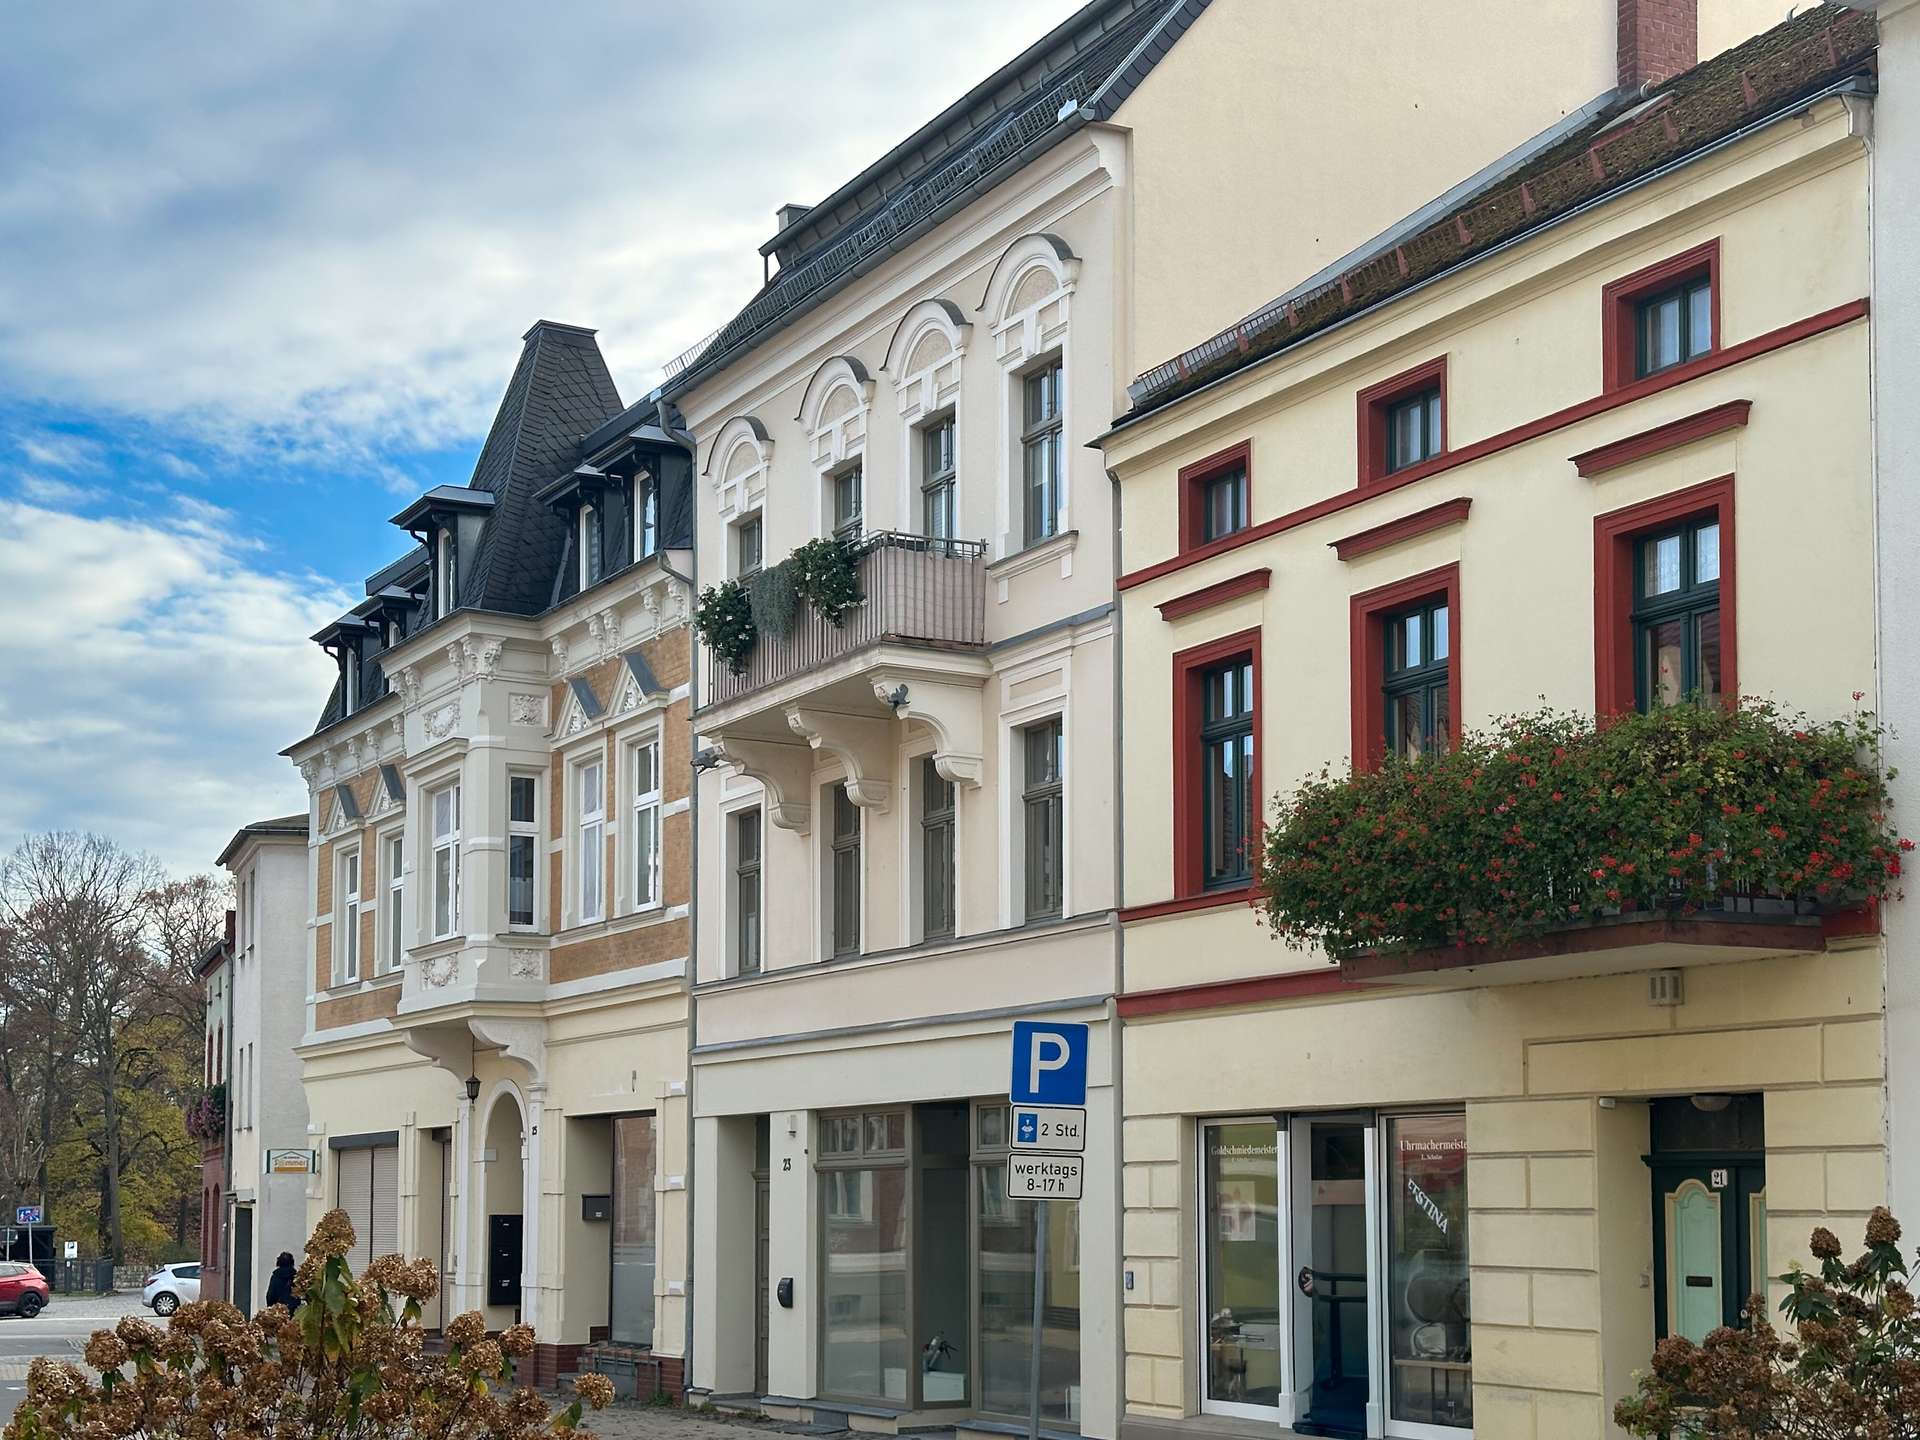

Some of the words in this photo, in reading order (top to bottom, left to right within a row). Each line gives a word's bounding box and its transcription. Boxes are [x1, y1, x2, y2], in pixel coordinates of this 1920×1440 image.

[1030, 1032, 1070, 1093] P
[1041, 1123, 1049, 1136] 2
[1056, 1124, 1080, 1137] Std.
[783, 1158, 791, 1171] 23
[1015, 1162, 1078, 1179] werktags
[1027, 1178, 1055, 1191] 8-17
[1058, 1179, 1064, 1192] h
[1713, 1171, 1723, 1185] 21
